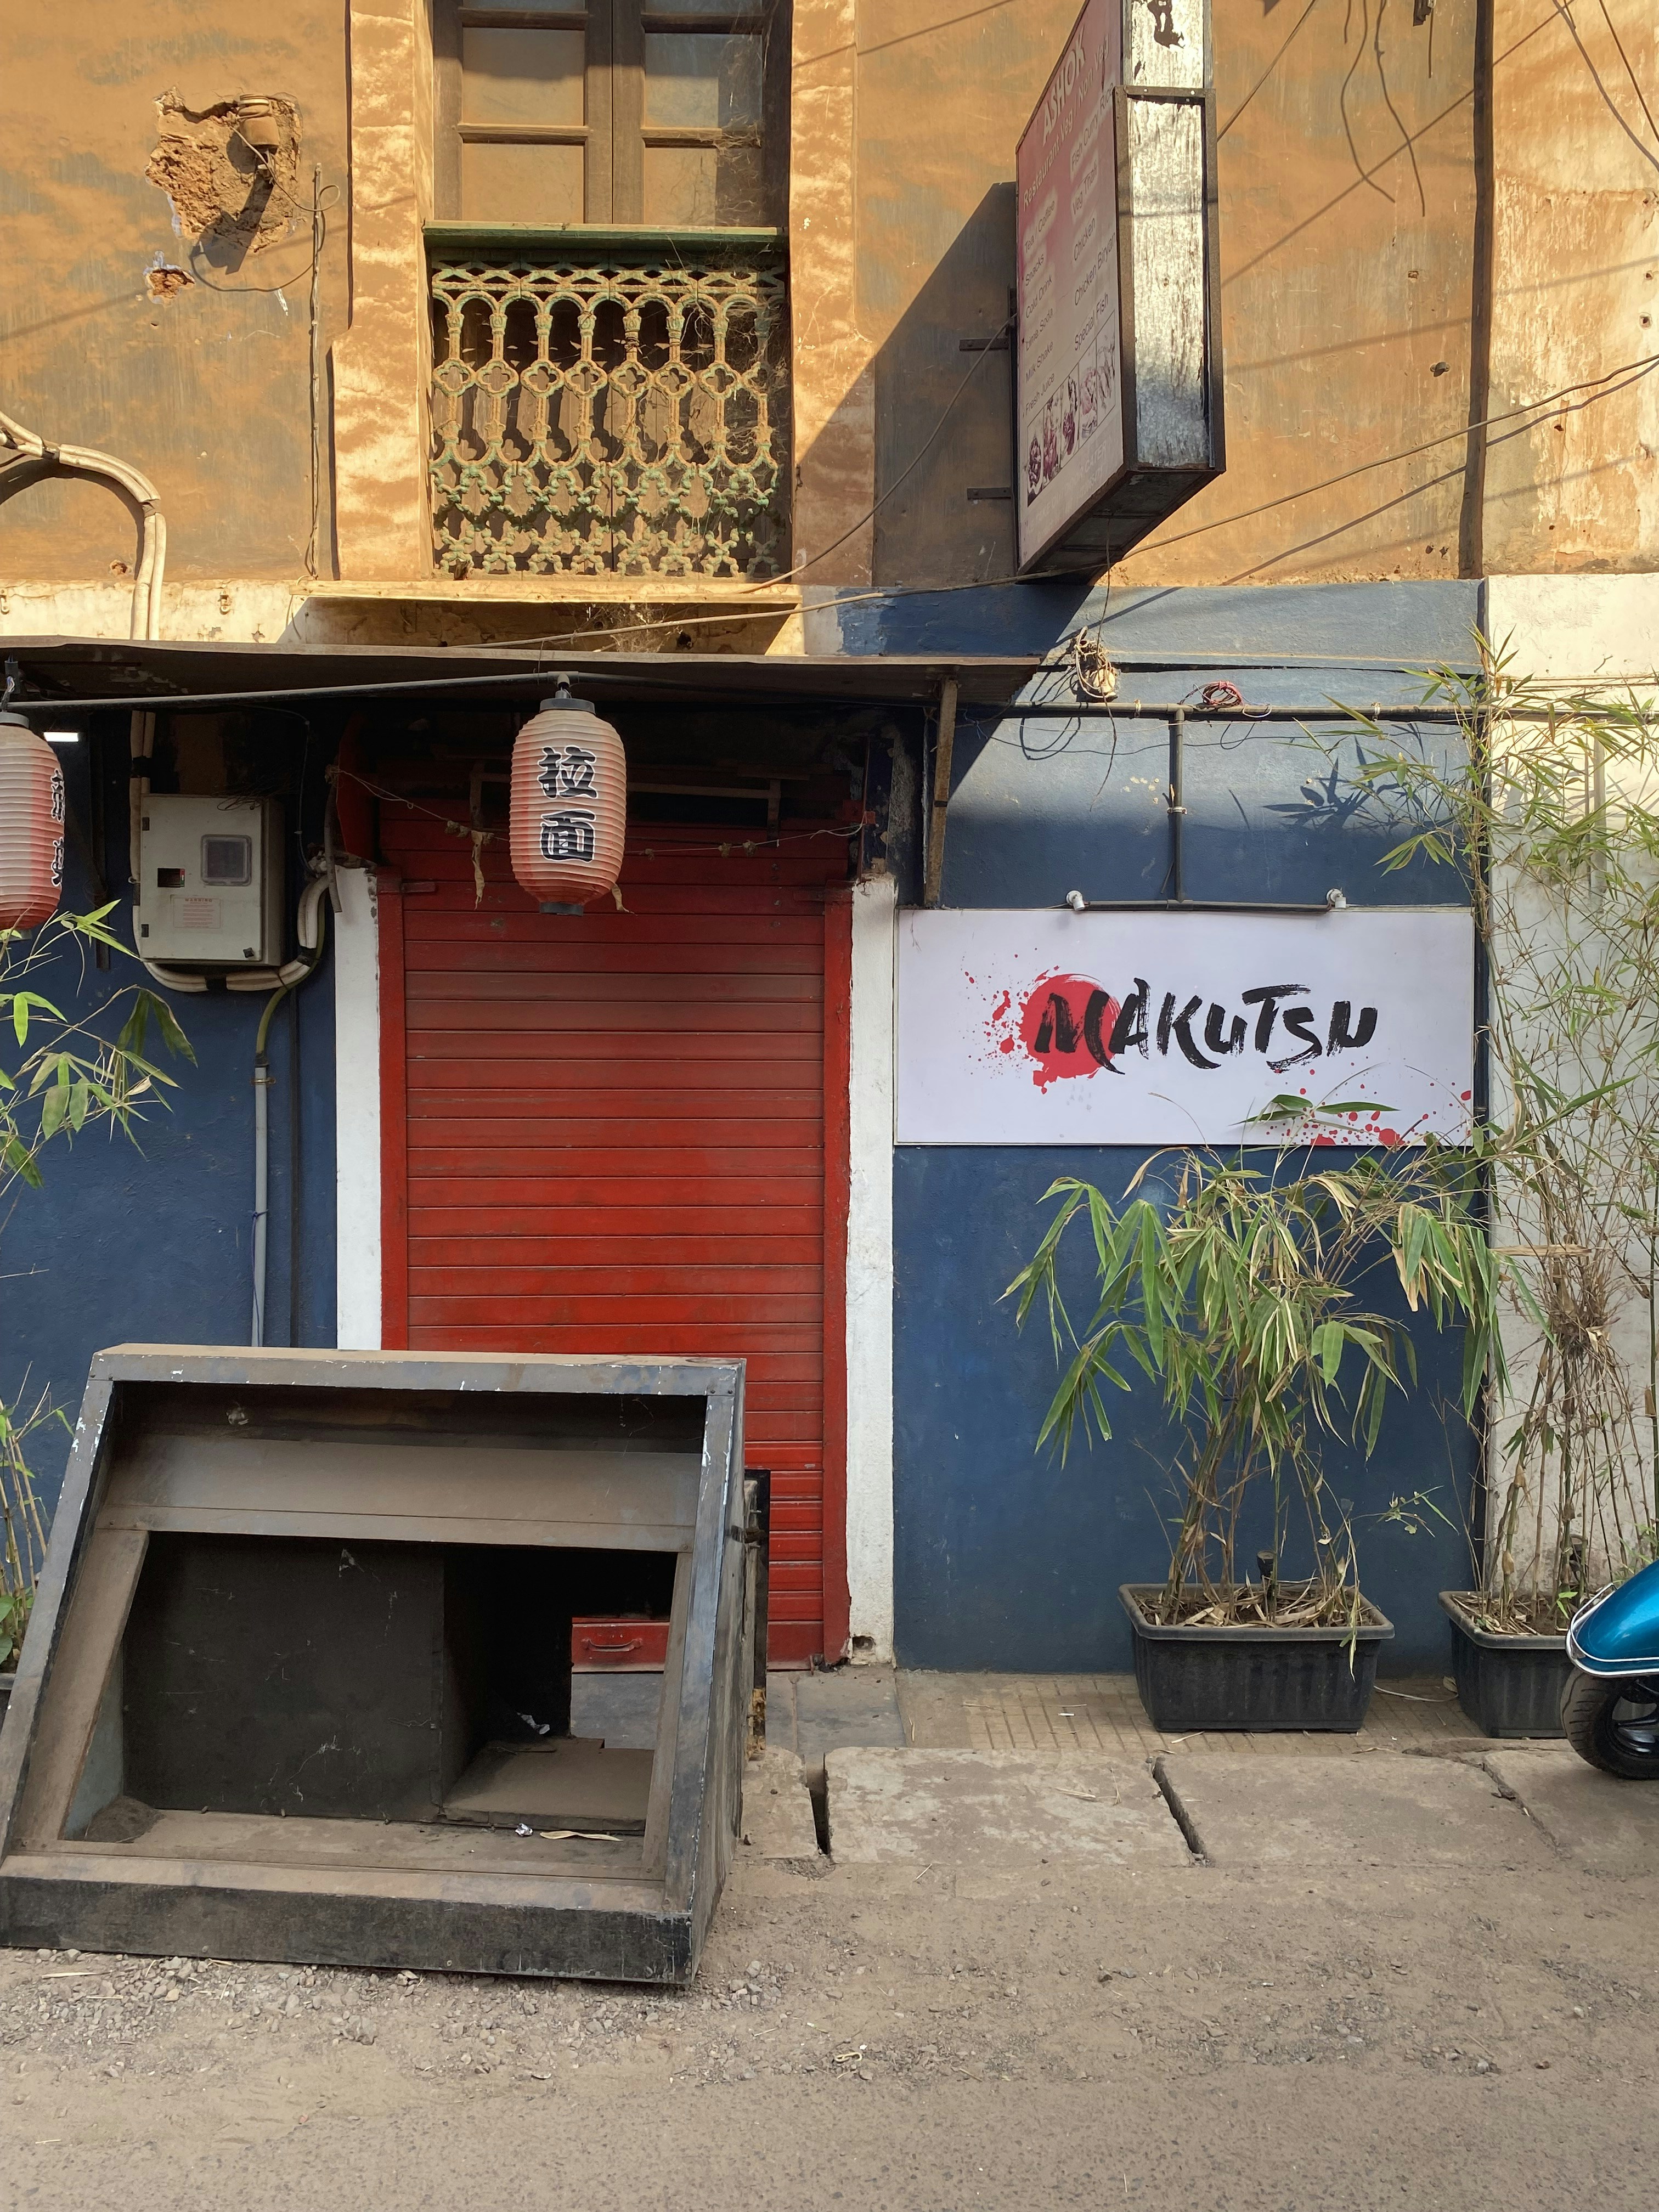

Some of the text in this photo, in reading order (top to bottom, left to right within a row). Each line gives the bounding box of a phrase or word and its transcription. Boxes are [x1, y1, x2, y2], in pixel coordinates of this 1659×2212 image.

[1043, 23, 1086, 147] ASHOK
[1024, 134, 1060, 212] Restaurant
[1060, 108, 1074, 142] Veg
[1079, 67, 1093, 108] Non
[1094, 33, 1109, 71] Veg
[1071, 83, 1113, 171] Fish Curry Rice
[1073, 191, 1083, 215] Veg
[1025, 235, 1034, 253] Tea
[1038, 201, 1055, 233] Coffee
[1074, 218, 1096, 261] Chicken
[1025, 254, 1044, 286] Snacks
[1075, 264, 1097, 306] Chicken
[1025, 275, 1052, 319] Cold Drink
[1026, 308, 1053, 352] Lime Soda
[1075, 292, 1109, 351] Special Fish
[1025, 341, 1053, 383] Milk Shake
[1026, 373, 1055, 415] Fresh Juice
[537, 745, 599, 863] 拉面
